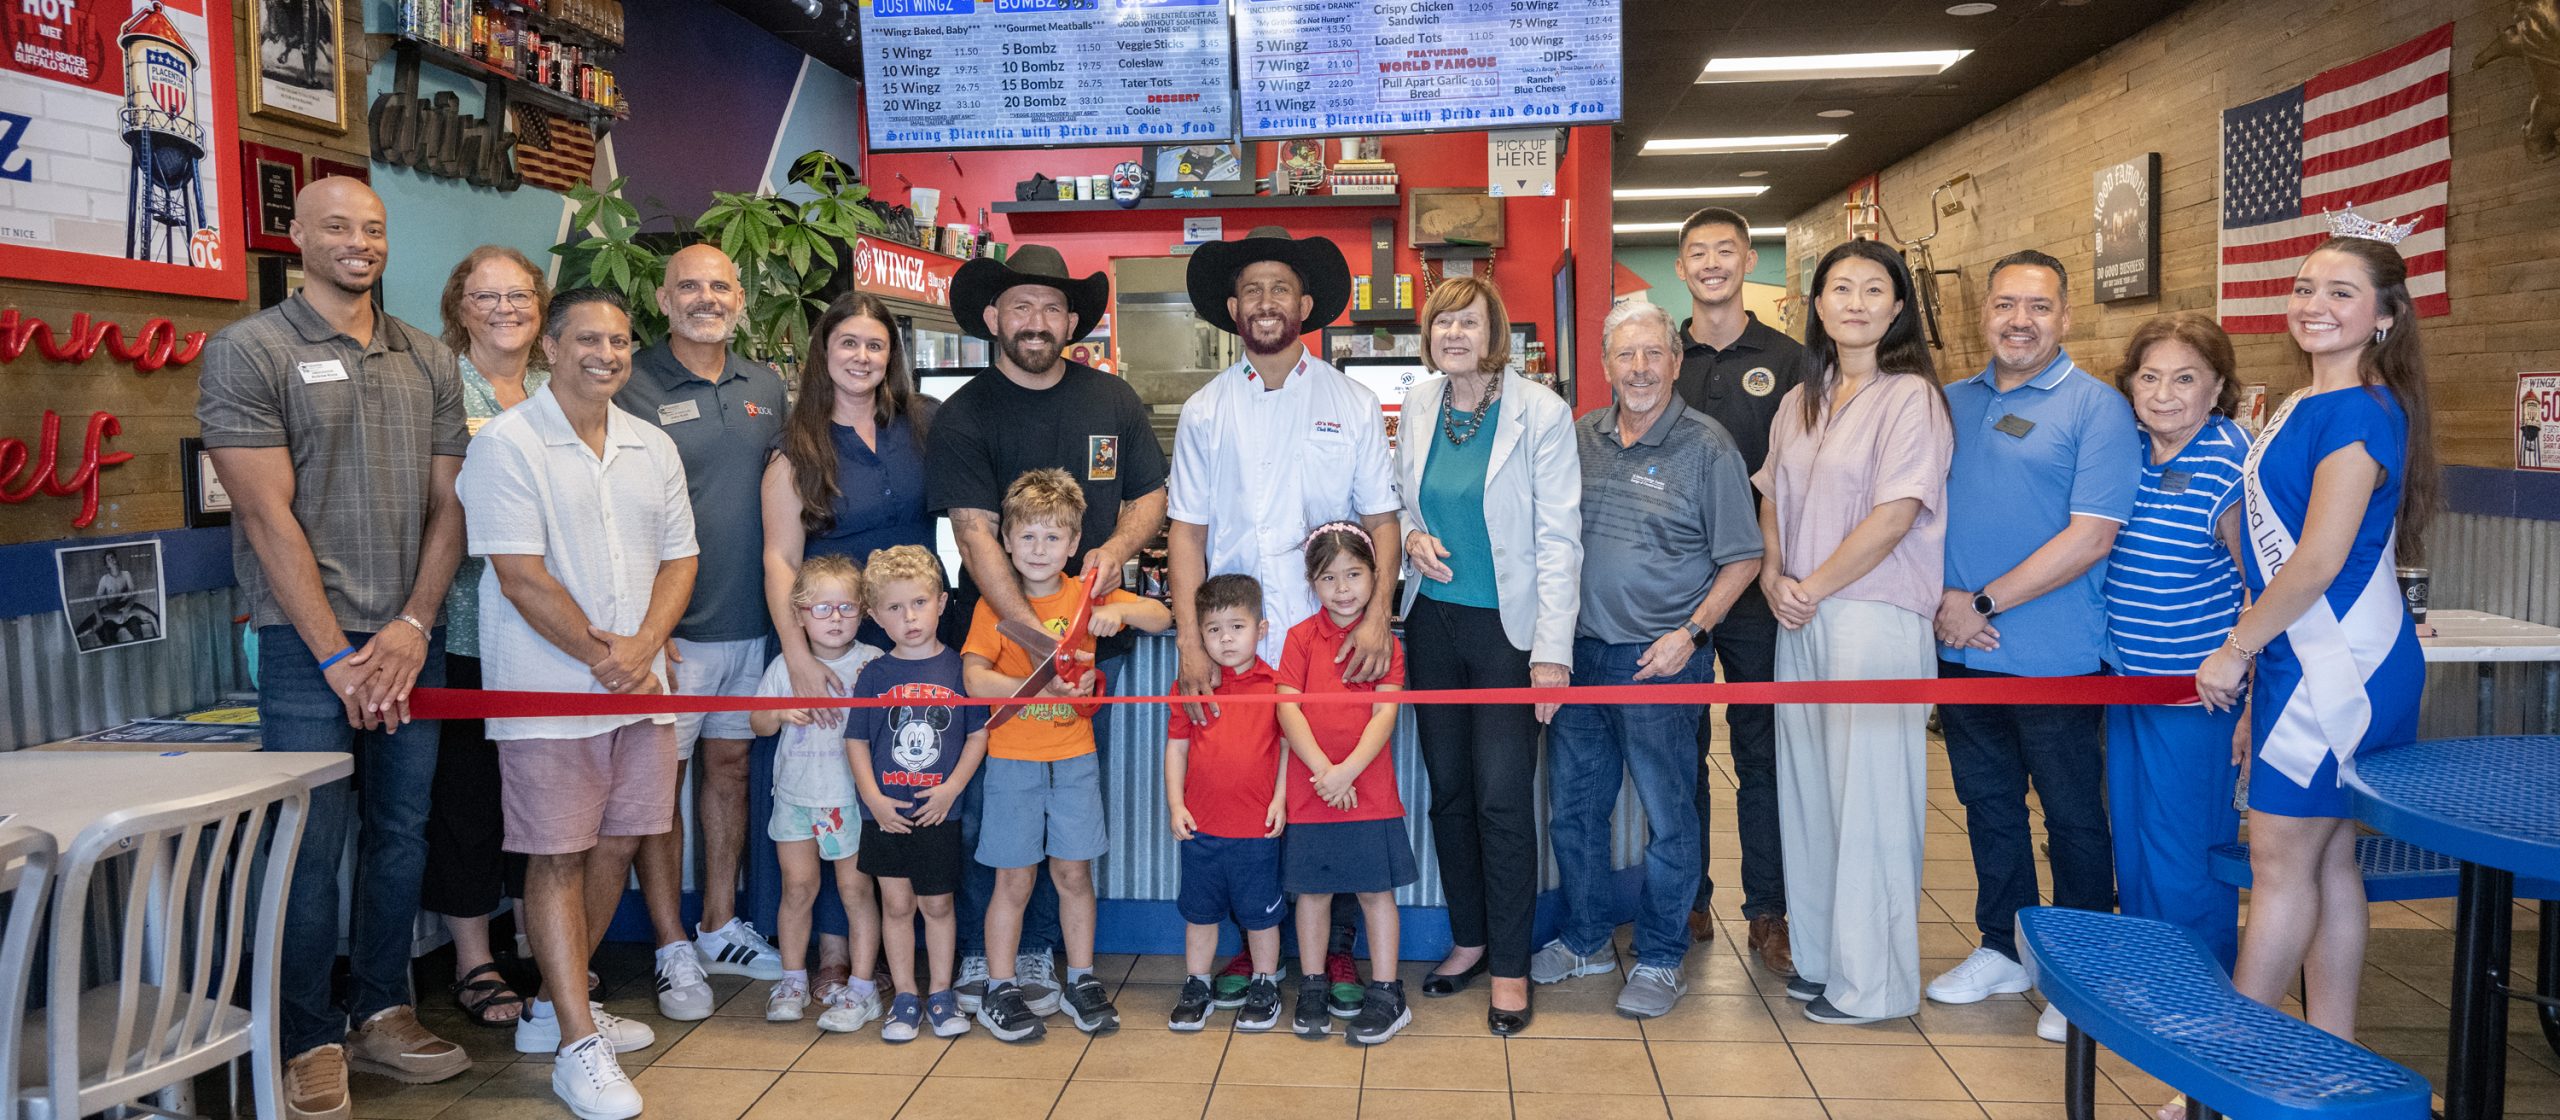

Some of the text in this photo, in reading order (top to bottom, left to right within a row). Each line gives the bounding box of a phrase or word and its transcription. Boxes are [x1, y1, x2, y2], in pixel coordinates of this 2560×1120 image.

[1287, 4, 1303, 12] ONE
[1373, 1, 1493, 15] Crispy Chicken 12.05
[1510, 1, 1523, 11] 50
[1526, 0, 1559, 11] Wingz
[23, 0, 75, 25] HOT
[1176, 18, 1218, 26] SOMETHING
[1321, 15, 1345, 24] Hungry
[1388, 14, 1440, 26] Sandwich
[1509, 16, 1613, 29] 75 Wingz 112.44
[39, 23, 62, 40] WET
[914, 26, 944, 36] Baked,
[1327, 25, 1351, 34] 13.50
[1117, 40, 1151, 51] Veggie
[1154, 40, 1184, 49] Sticks
[1375, 32, 1494, 46] Loaded Tots 11.05
[1509, 33, 1613, 47] 100 Wingz 145.95
[1002, 42, 1100, 55] 5 Bombz 11.50
[1256, 39, 1352, 53] 5 Wingz 18.90
[17, 41, 87, 67] A MUCH SPICER
[882, 47, 978, 60] 5 Wingz 11.50
[1407, 48, 1468, 58] FEATURING
[1539, 50, 1578, 62] -DIPS-
[15, 52, 89, 78] BUFFALO SAUCE
[1002, 60, 1101, 73] 10 Bombz 19.75
[1118, 58, 1219, 68] Coleslaw 4.45
[1257, 60, 1352, 73] 7 Wingz 21.10
[1378, 56, 1497, 72] WORLD FAMOUS
[152, 66, 183, 83] PLACENTIA
[883, 64, 978, 78] 10 Wingz 19.75
[1002, 78, 1102, 91] 15 Bombz 26.75
[1121, 77, 1220, 88] Tater Tots 4.45
[1258, 79, 1353, 92] 9 Wingz 22.20
[1383, 75, 1496, 88] Pull Apart Garlic 10.50
[1526, 75, 1608, 86] Ranch 0.85
[883, 82, 979, 95] 15 Wingz 26.75
[1410, 88, 1440, 99] Bread
[1514, 85, 1566, 94] Blue Cheese
[1004, 95, 1103, 108] 20 Bombz 33.10
[1147, 93, 1200, 103] DESSERT
[1256, 98, 1353, 111] 11 Wingz 25.50
[883, 100, 898, 111] 20
[902, 99, 941, 112] Wingz
[1126, 105, 1221, 115] Cookie 4.45
[1260, 101, 1604, 129] Serving Placentia with Pride and Good Food
[886, 121, 1215, 142] Serving Placentia with Pride and Good Food
[1496, 138, 1547, 151] PICK UP
[1496, 150, 1547, 167] HERE
[2094, 163, 2149, 222] HOOD FAMOUS
[193, 241, 221, 270] OC
[872, 247, 925, 292] WINGZ
[2529, 377, 2556, 389] WINGZ
[2247, 459, 2264, 530] Yorba
[2258, 529, 2286, 577] Lin
[883, 770, 943, 787] MOUSE
